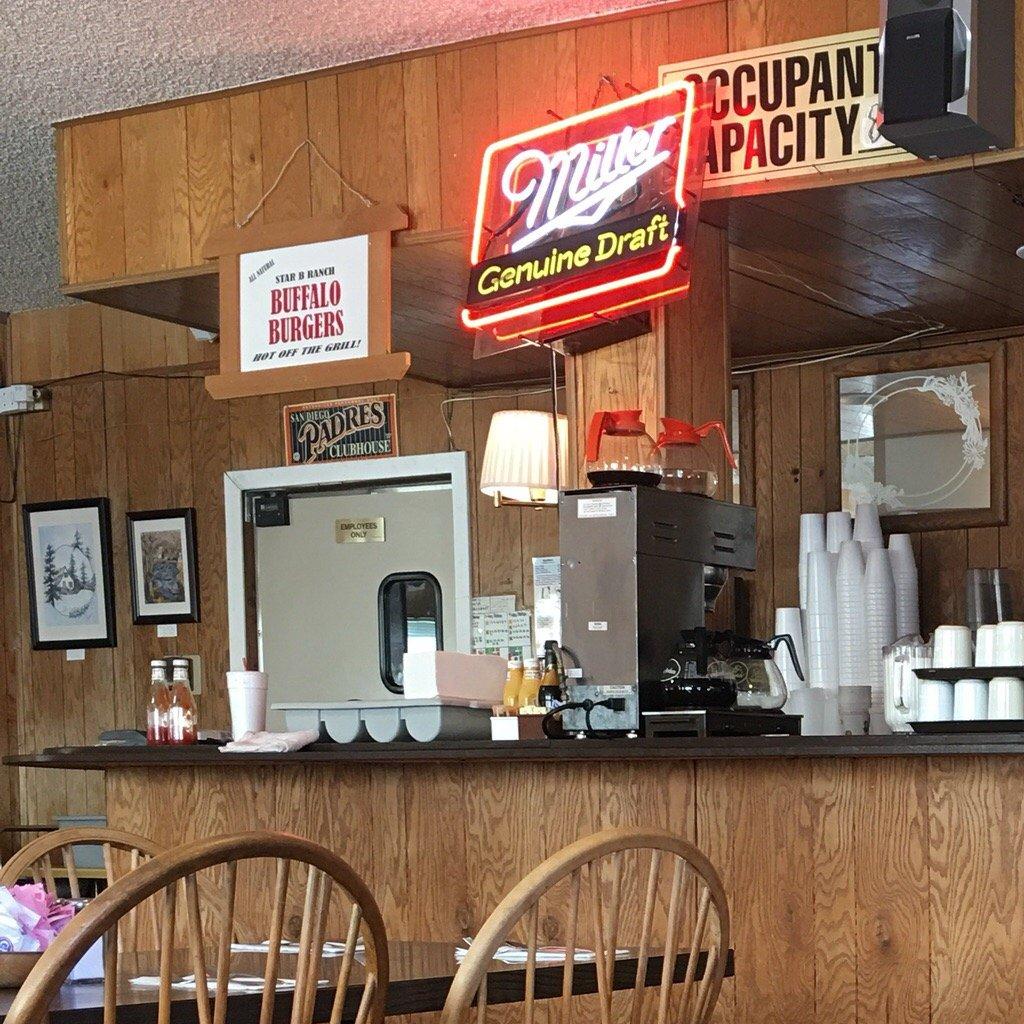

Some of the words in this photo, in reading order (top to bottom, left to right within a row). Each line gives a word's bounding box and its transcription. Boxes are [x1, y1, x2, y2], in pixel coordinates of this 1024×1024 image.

[703, 103, 860, 174] APACITY
[501, 115, 677, 252] Miller
[477, 244, 591, 295] Genuine
[595, 213, 669, 263] Draft
[275, 272, 296, 284] STAR
[298, 271, 305, 280] B
[307, 266, 335, 279] RANCH
[270, 280, 341, 315] BUFFALO
[268, 309, 344, 345] BURGERS
[252, 351, 276, 362] HOT
[278, 348, 299, 358] OFF
[301, 345, 322, 356] THE
[324, 340, 361, 352] GRILL!
[290, 413, 304, 423] SAN
[306, 409, 330, 421] DIEGO
[298, 401, 385, 464] PADRES
[329, 439, 391, 458] CLUBHOUSE
[340, 522, 378, 530] EMPLOYEES
